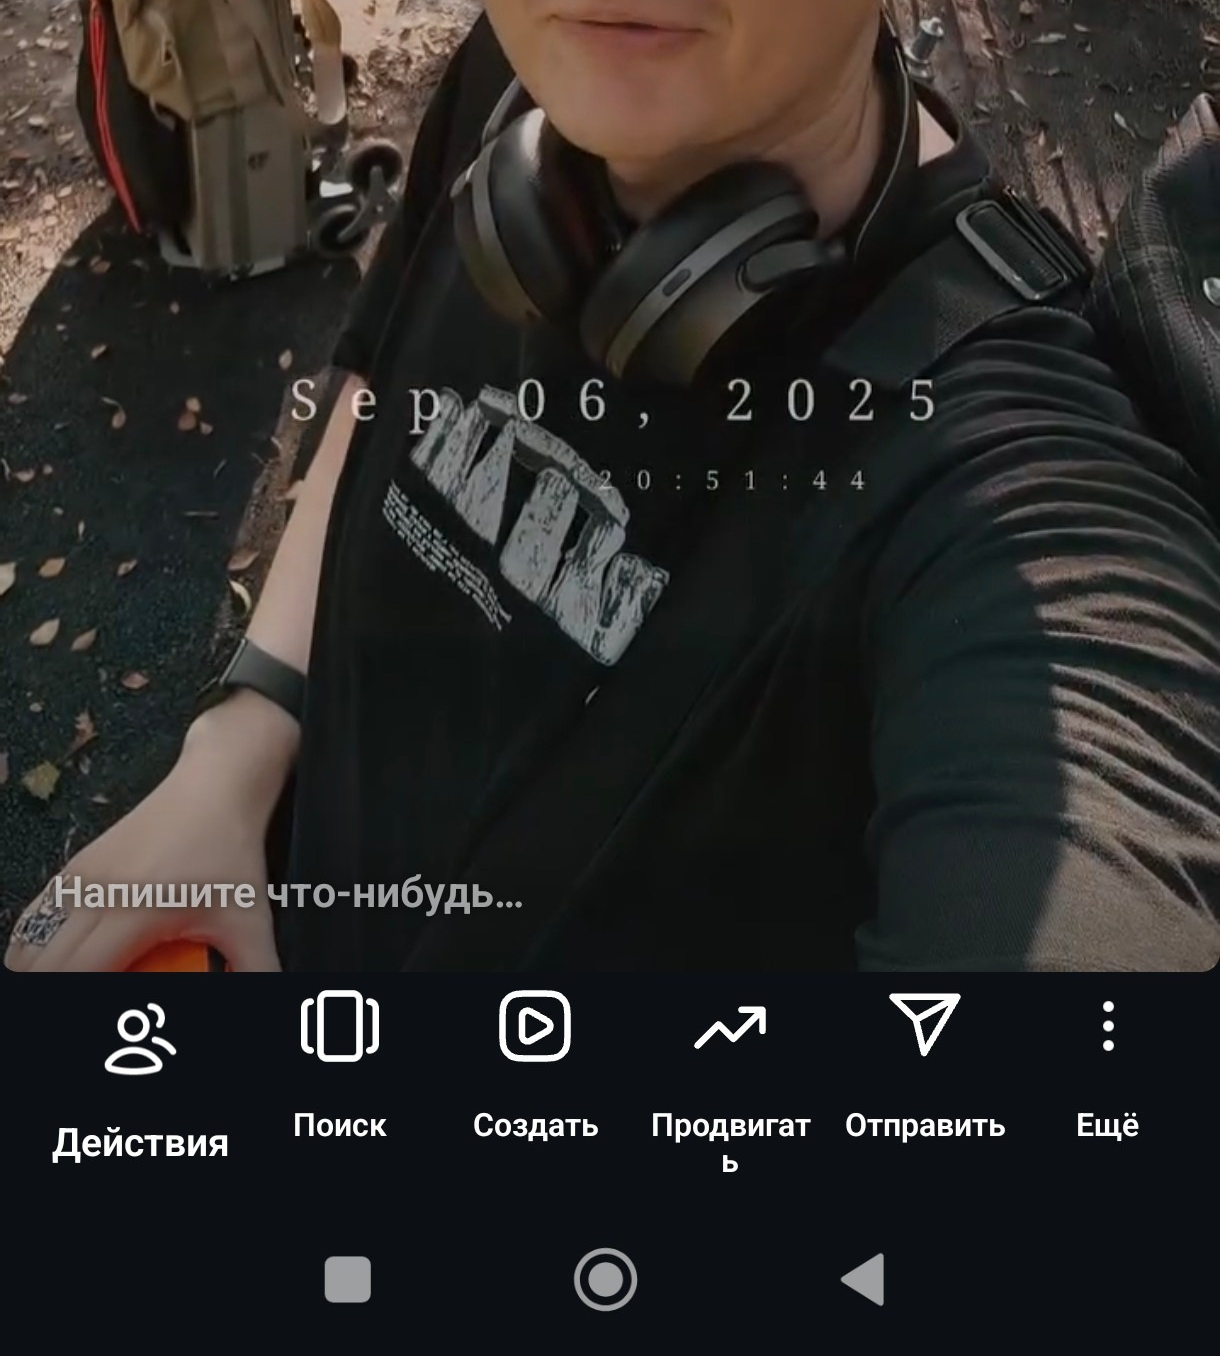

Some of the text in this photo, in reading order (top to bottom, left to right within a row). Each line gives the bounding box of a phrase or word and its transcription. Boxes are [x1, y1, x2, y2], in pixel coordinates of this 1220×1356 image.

[293, 1112, 388, 1138] Поиск
[473, 1112, 600, 1142] Создать
[651, 1112, 812, 1144] Продвигат
[845, 1112, 1006, 1144] Отправить
[1076, 1112, 1140, 1142] Ещё
[51, 1126, 229, 1164] Действия
